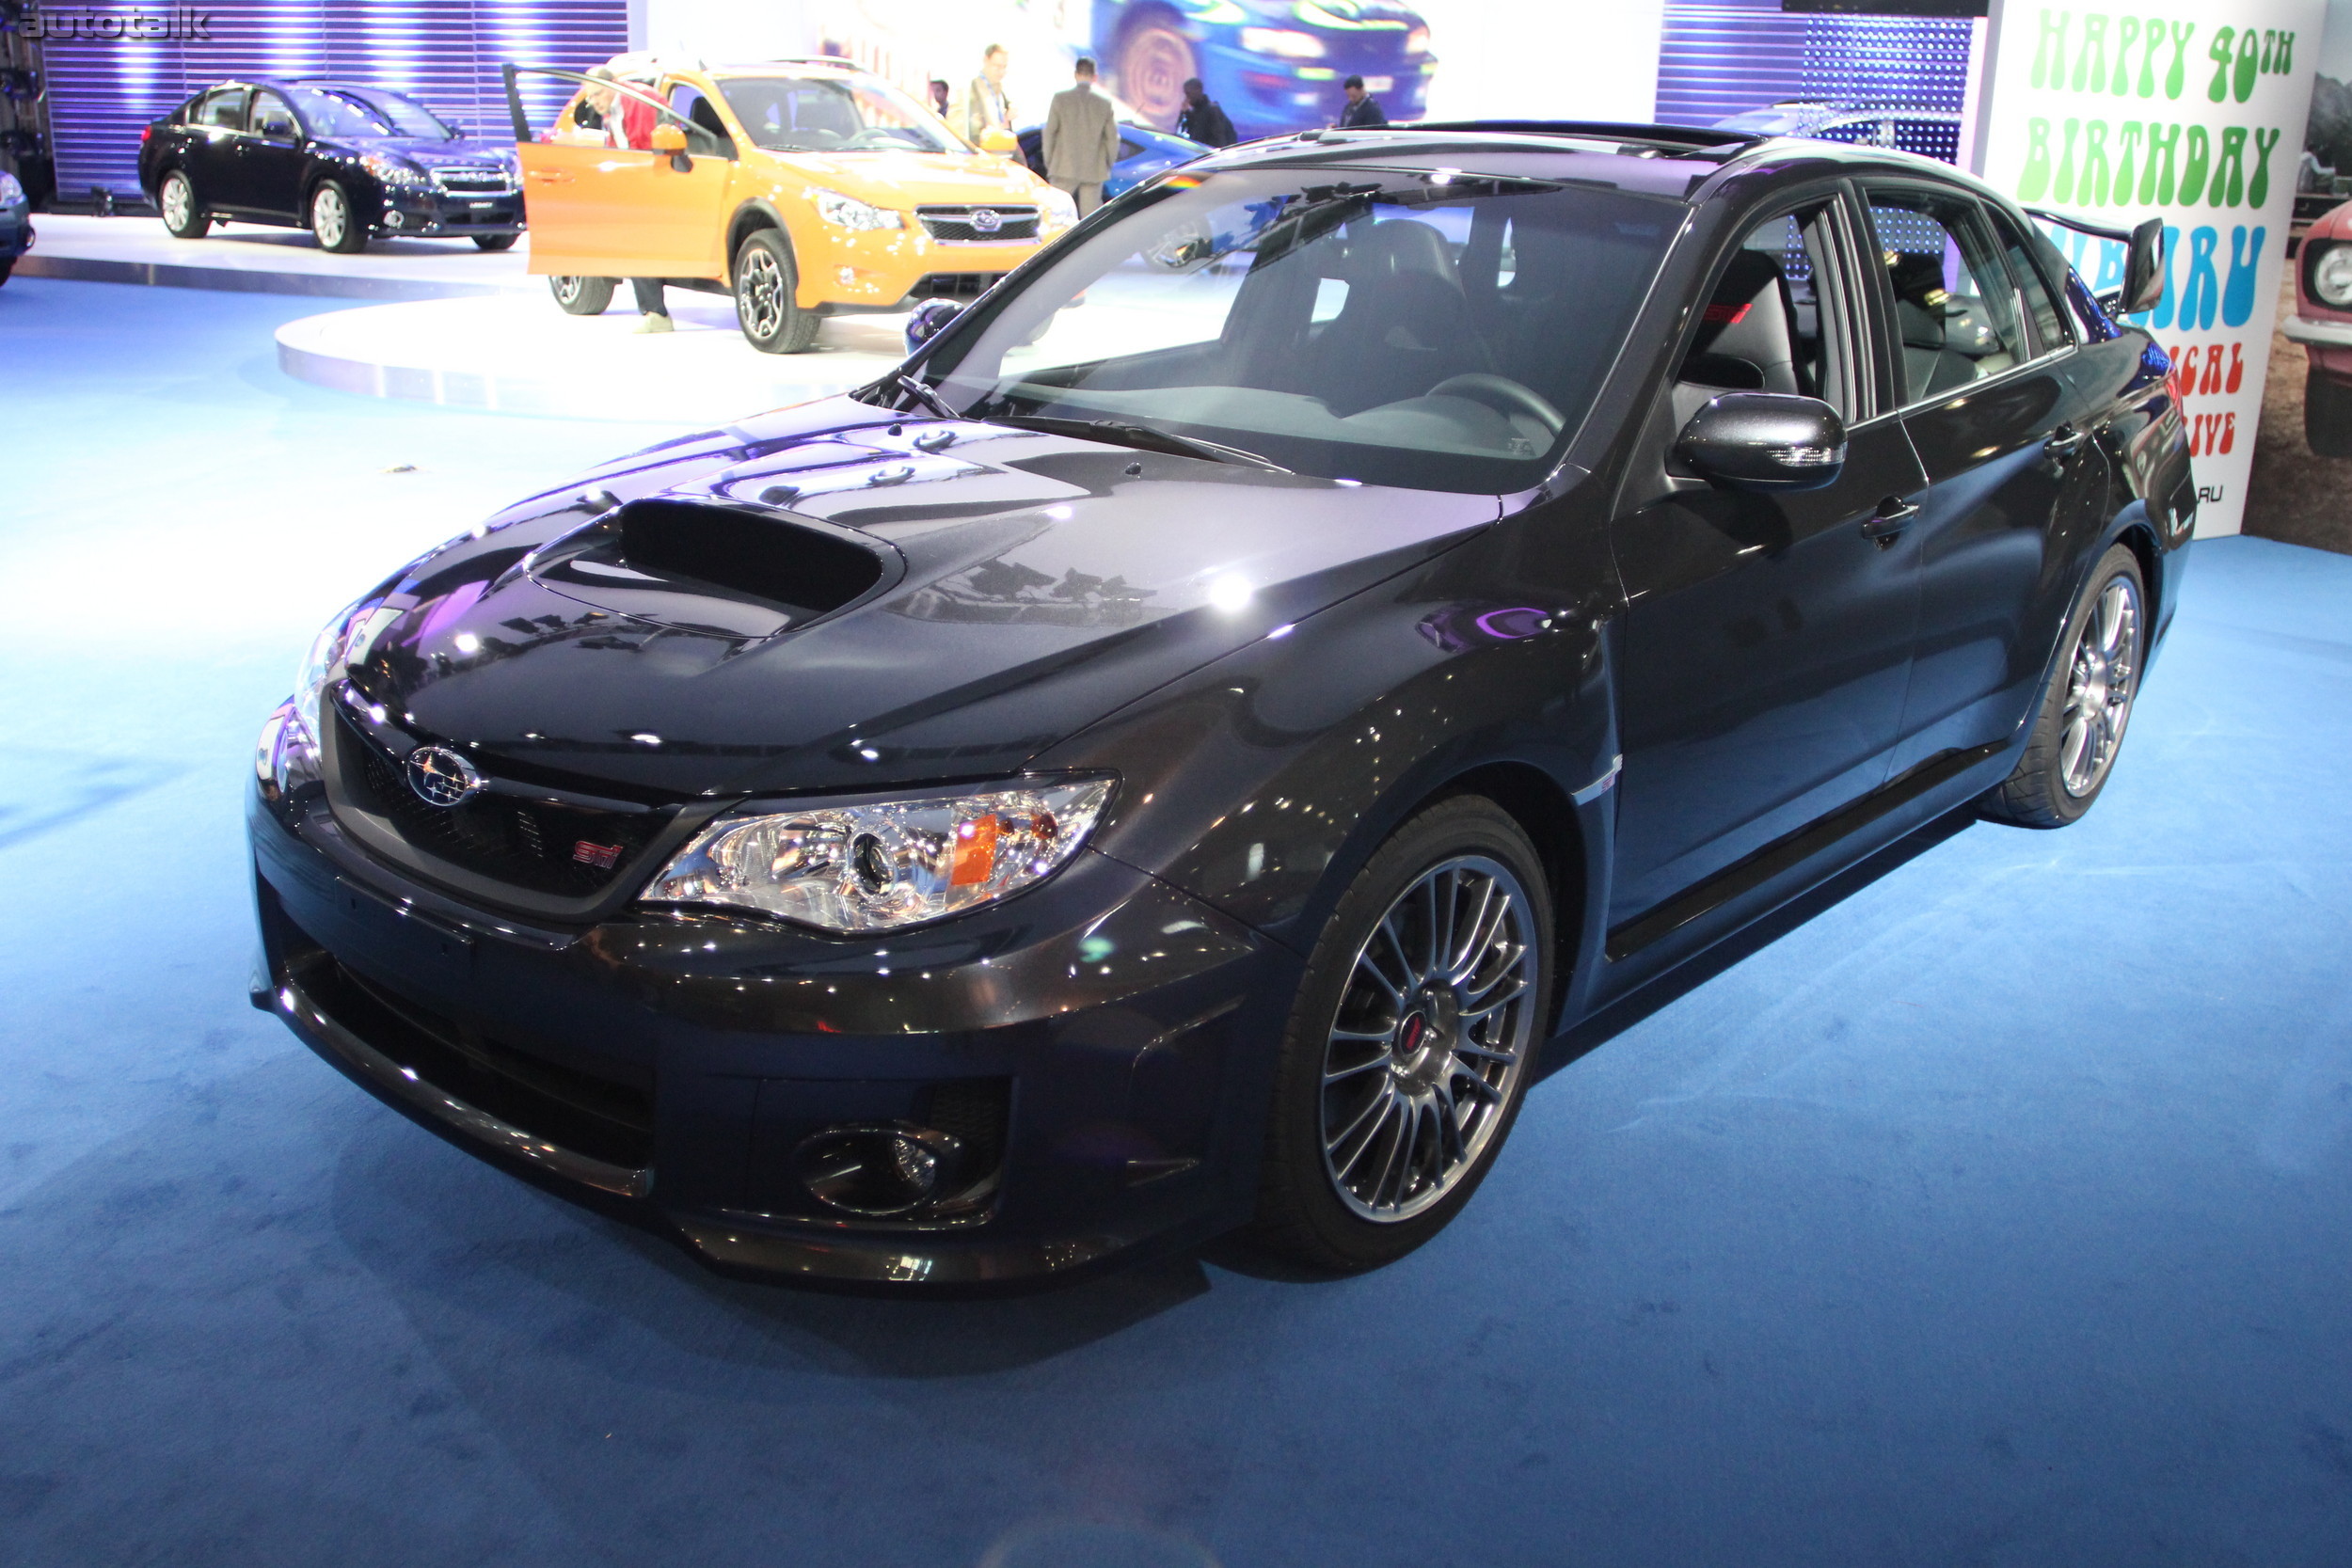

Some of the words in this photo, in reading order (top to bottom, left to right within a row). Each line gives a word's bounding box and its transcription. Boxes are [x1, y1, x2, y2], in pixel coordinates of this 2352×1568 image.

[2030, 8, 2196, 101] HAPPY
[2016, 117, 2281, 210] BIRTHDAY
[2183, 412, 2235, 457] IVE
